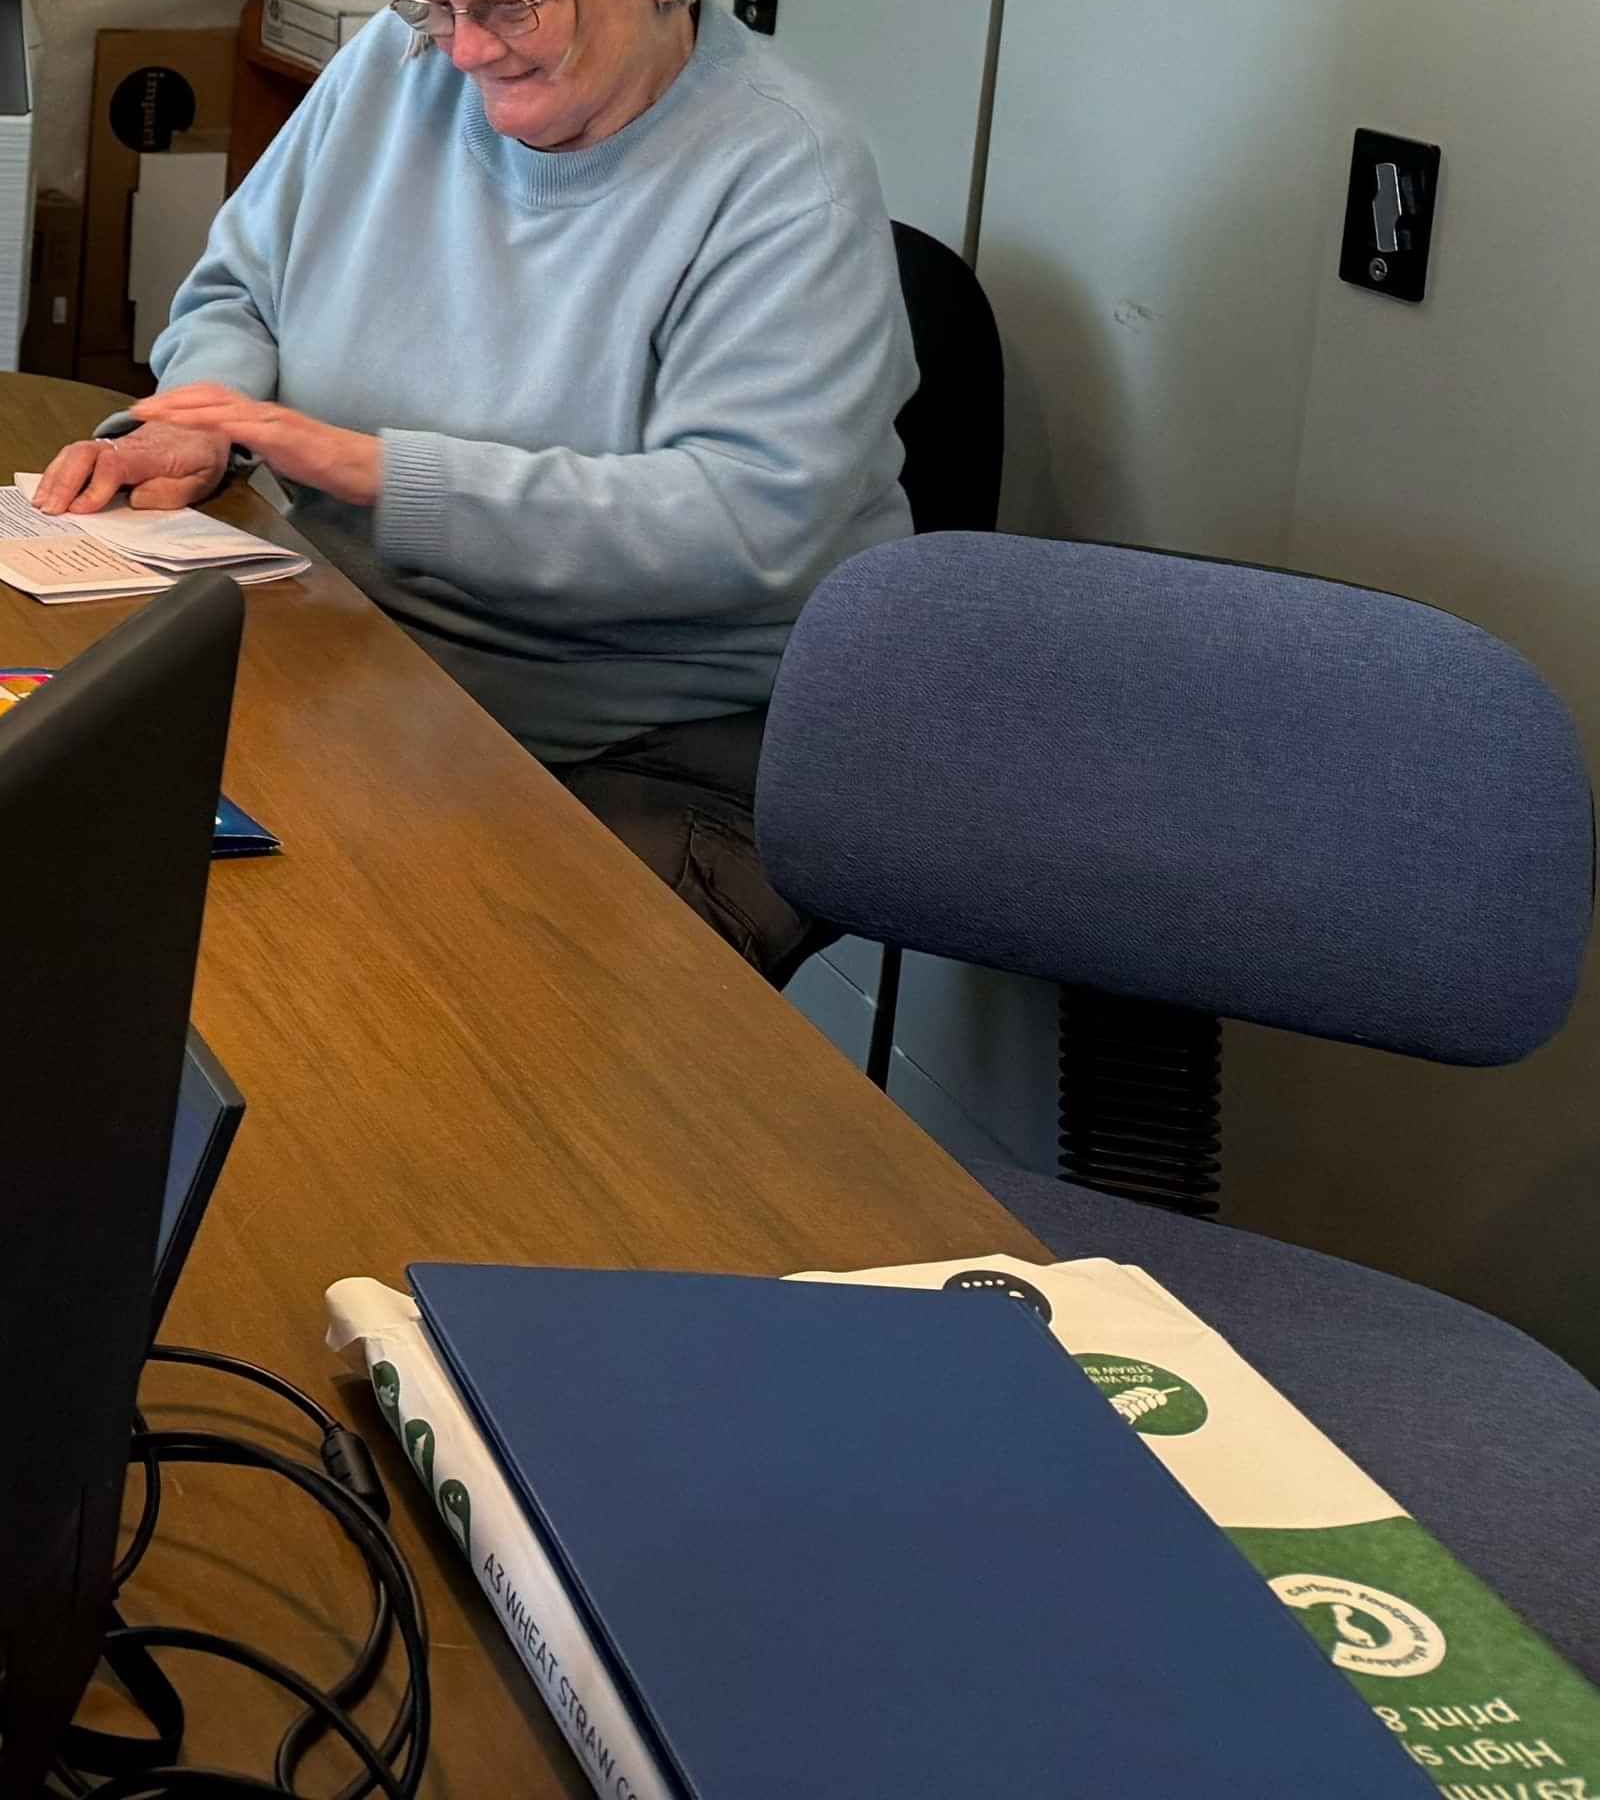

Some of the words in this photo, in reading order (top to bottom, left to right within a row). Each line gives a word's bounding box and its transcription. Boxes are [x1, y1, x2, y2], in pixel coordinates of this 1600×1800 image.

[483, 1553, 505, 1594] A3
[505, 1582, 559, 1684] WHEAT
[558, 1675, 617, 1784] STRAW
[1408, 1698, 1521, 1732] print
[1446, 1737, 1567, 1771] High
